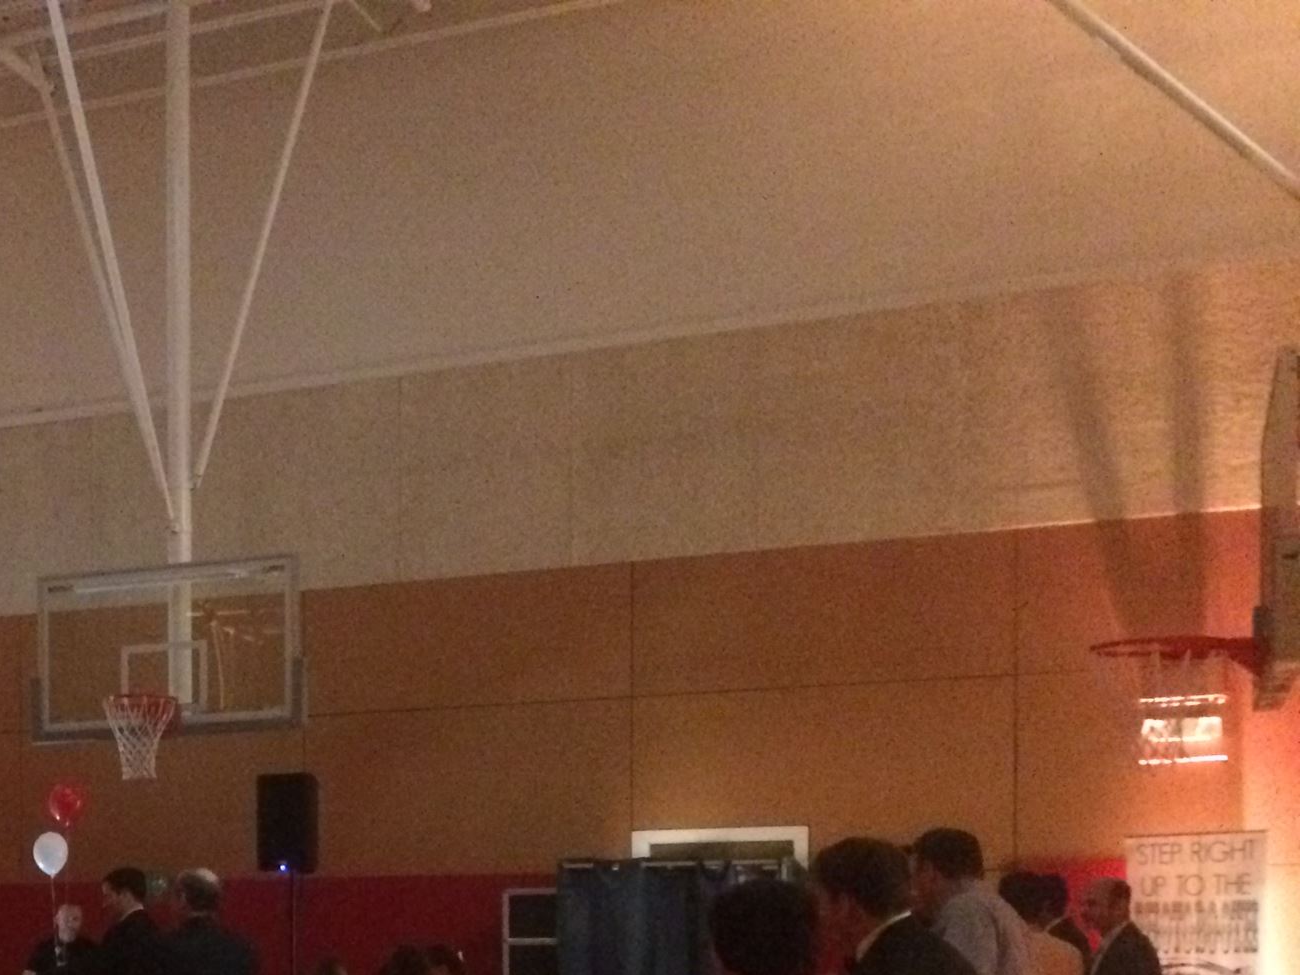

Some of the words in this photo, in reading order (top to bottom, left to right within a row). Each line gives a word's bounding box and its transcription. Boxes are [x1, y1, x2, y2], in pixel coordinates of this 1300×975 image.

[1136, 842, 1182, 865] STEP
[1190, 839, 1254, 862] RIGHT
[1141, 875, 1165, 896] UP
[1175, 873, 1207, 896] TO
[1212, 872, 1251, 895] THE
